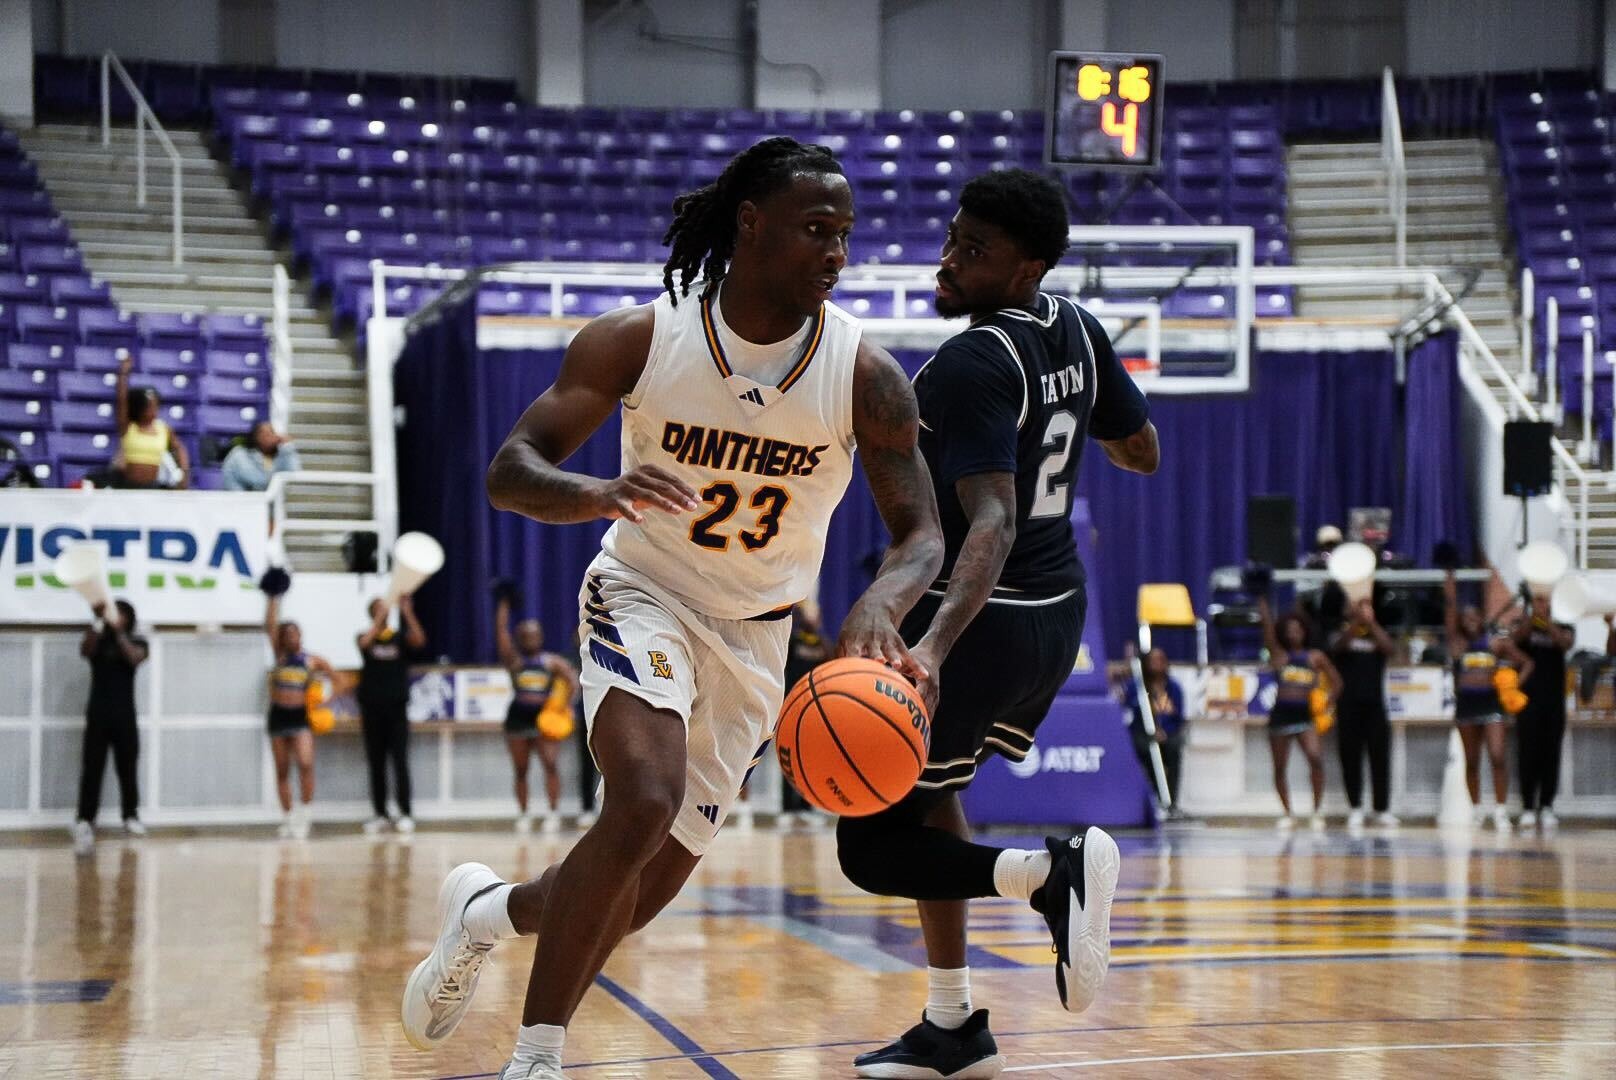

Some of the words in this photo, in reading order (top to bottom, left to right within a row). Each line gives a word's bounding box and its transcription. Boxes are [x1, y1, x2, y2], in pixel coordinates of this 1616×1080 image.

[1101, 101, 1138, 157] 4
[661, 420, 831, 477] PANTHERS
[1028, 408, 1078, 519] 2
[687, 480, 793, 553] 23
[0, 526, 255, 589] ISTRA
[1041, 745, 1105, 773] AT&T
